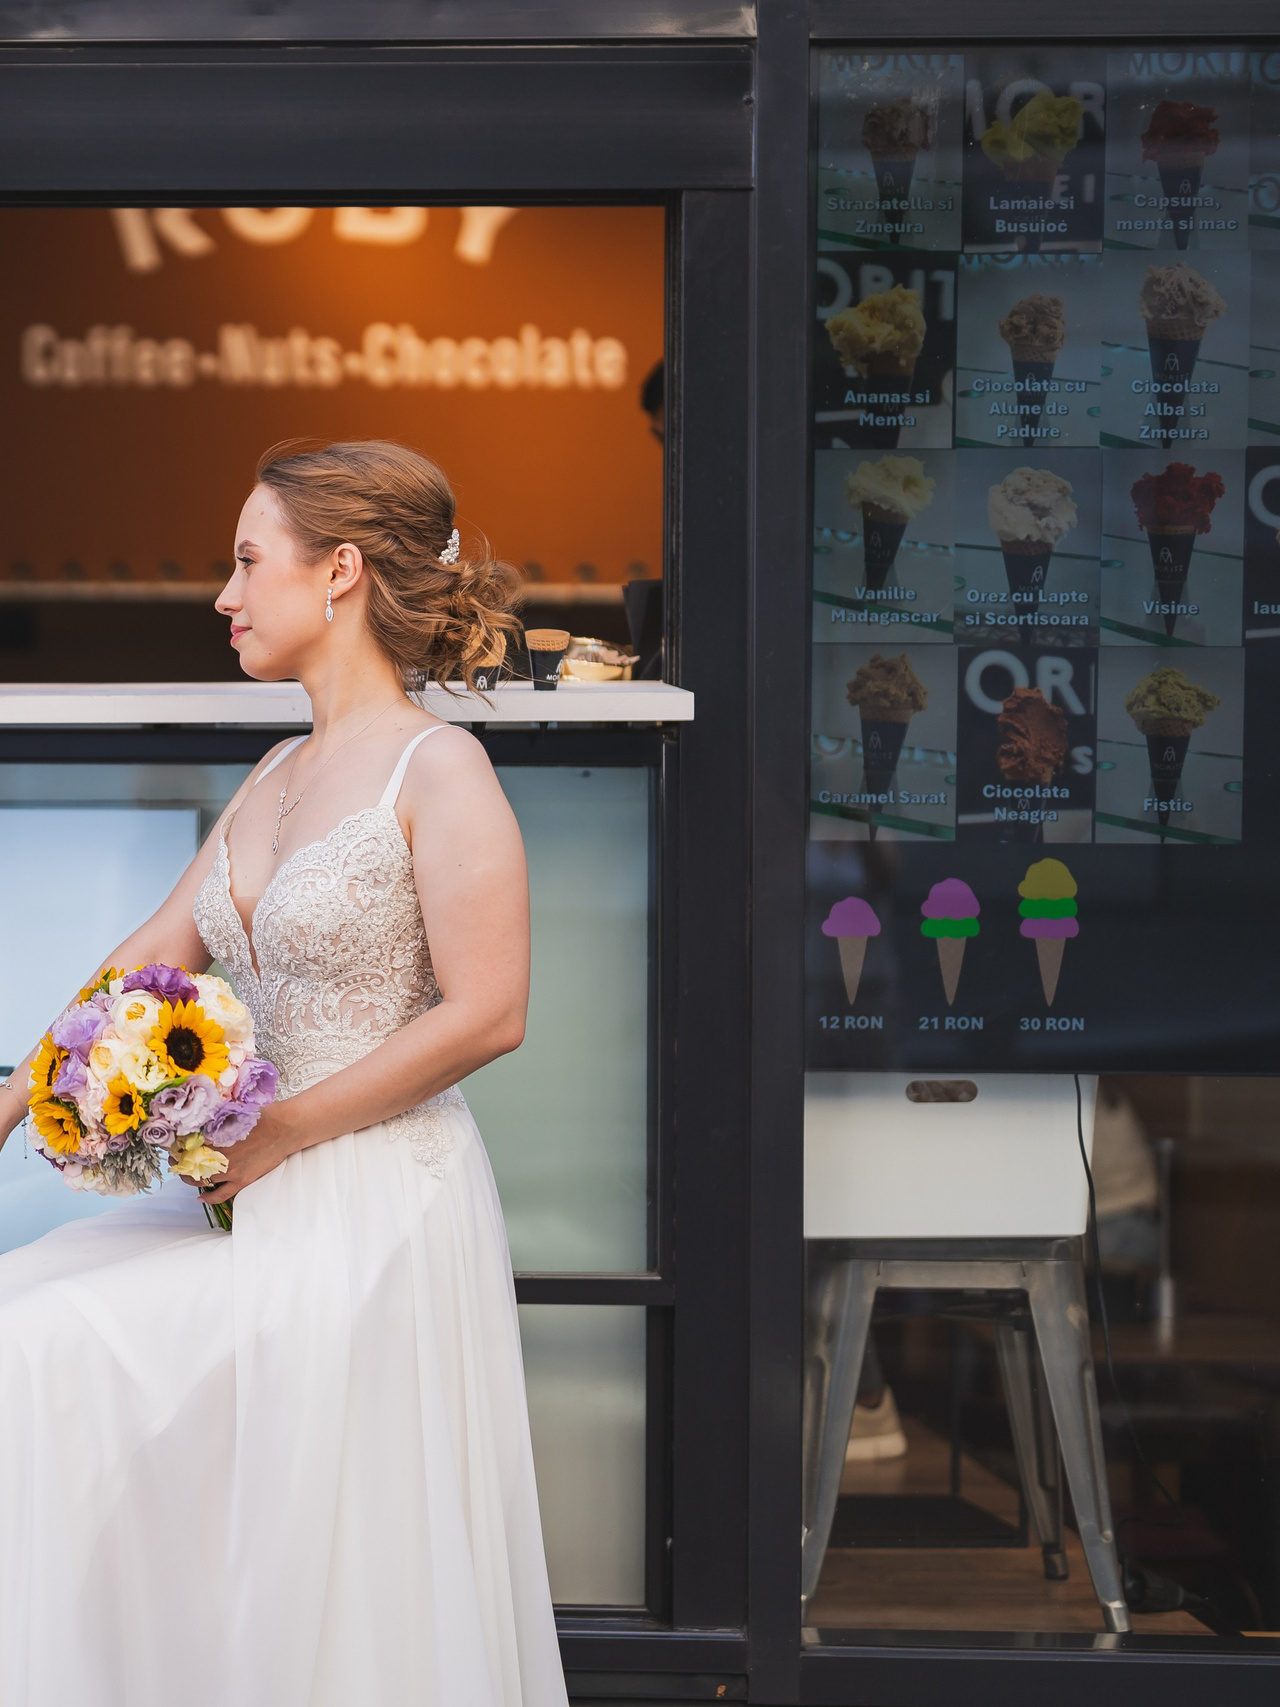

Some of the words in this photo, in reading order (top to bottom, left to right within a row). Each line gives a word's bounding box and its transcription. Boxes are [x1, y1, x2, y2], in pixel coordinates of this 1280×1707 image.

[827, 197, 934, 211] Straciatella
[937, 197, 953, 211] si
[989, 197, 1055, 211] Lamaie
[1059, 197, 1075, 211] si
[1134, 194, 1222, 210] Capsuna,
[855, 220, 925, 234] Zmeura
[995, 219, 1068, 233] Busuioc
[1116, 218, 1175, 231] menta
[1178, 217, 1194, 231] si
[1198, 219, 1238, 231] mac
[972, 379, 1061, 393] Ciocolata
[1065, 382, 1087, 393] cu
[1131, 379, 1220, 394] Ciocolata
[844, 390, 910, 404] Ananas
[914, 390, 930, 404] si
[989, 402, 1042, 415] Alune
[1046, 402, 1069, 415] de
[1144, 403, 1185, 416] Alba
[1189, 403, 1206, 416] si
[859, 413, 916, 427] Menta
[996, 424, 1061, 438] Padure
[1139, 425, 1209, 440] Zmeura
[854, 586, 917, 601] Vanilie
[966, 589, 1008, 603] Orez
[1012, 592, 1034, 603] cu
[1038, 589, 1089, 605] Lapte
[1142, 600, 1199, 615] Visine
[831, 609, 941, 626] Madagascar
[965, 611, 981, 625] si
[985, 611, 1089, 626] Scortisoara
[818, 790, 895, 804] Caramel
[898, 791, 948, 805] Sarat
[982, 784, 1070, 798] Ciocolata
[1143, 798, 1194, 812] Fistic
[994, 807, 1058, 823] Neagra
[819, 1016, 840, 1029] 12
[844, 1016, 883, 1030] RON
[919, 1017, 939, 1030] 21
[944, 1017, 984, 1030] RON
[1019, 1018, 1041, 1031] 30
[1045, 1018, 1085, 1031] RON
